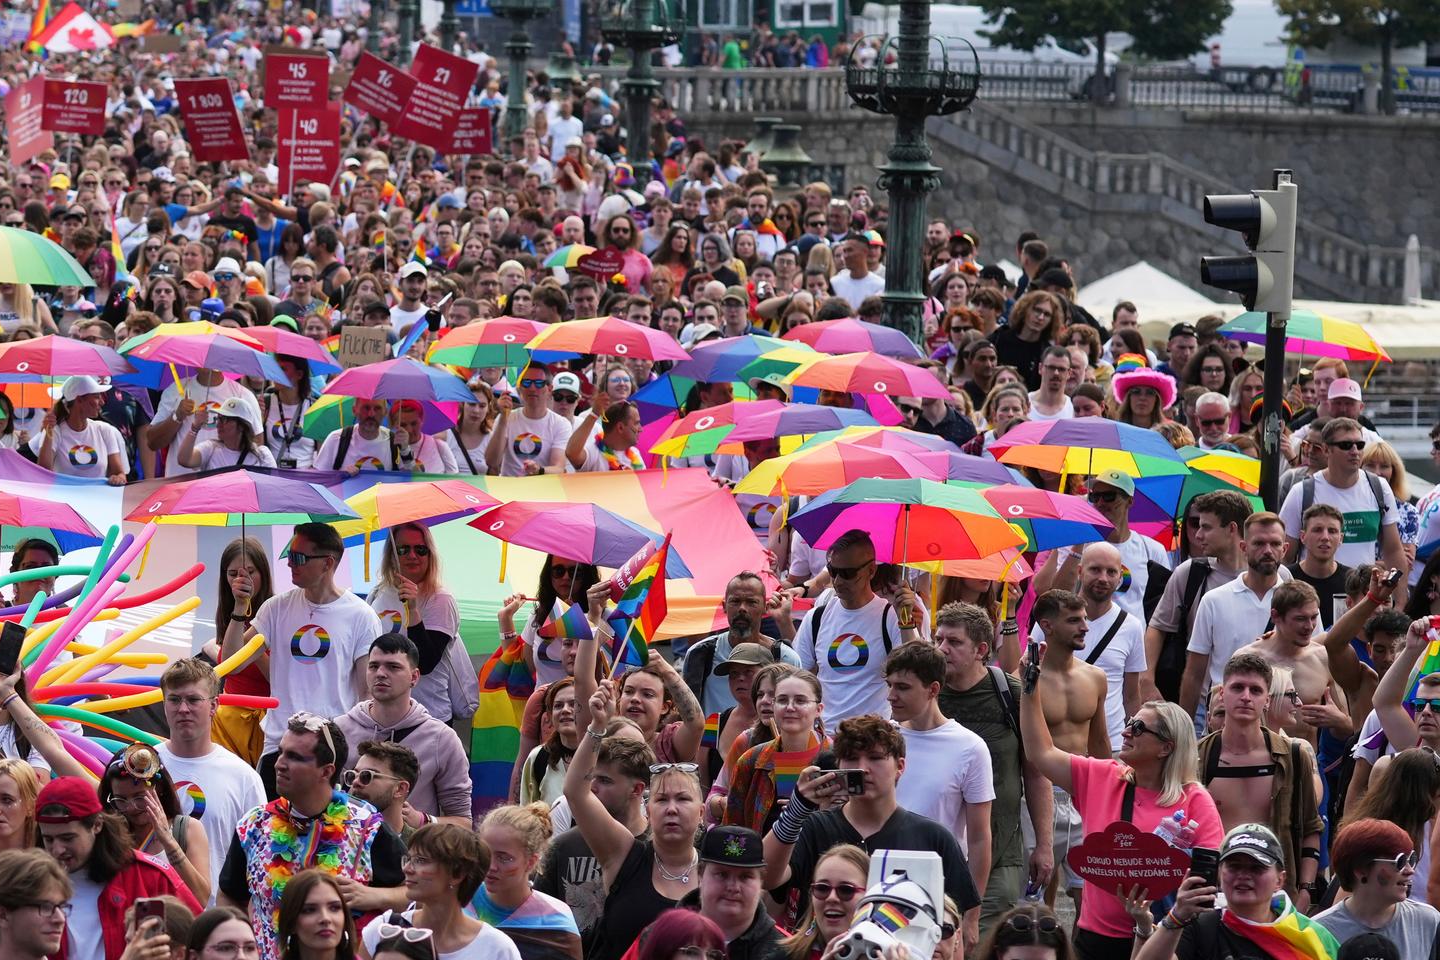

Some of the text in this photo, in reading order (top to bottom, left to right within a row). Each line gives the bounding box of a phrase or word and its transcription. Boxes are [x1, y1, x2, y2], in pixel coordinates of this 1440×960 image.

[288, 63, 307, 79] 45
[377, 69, 394, 88] 16
[433, 67, 451, 85] 21
[64, 89, 88, 105] 120
[300, 118, 318, 135] 40
[1086, 856, 1172, 866] DOKUD NEBUDE ROVNÉ
[1129, 868, 1171, 878] NEVZDÁME
